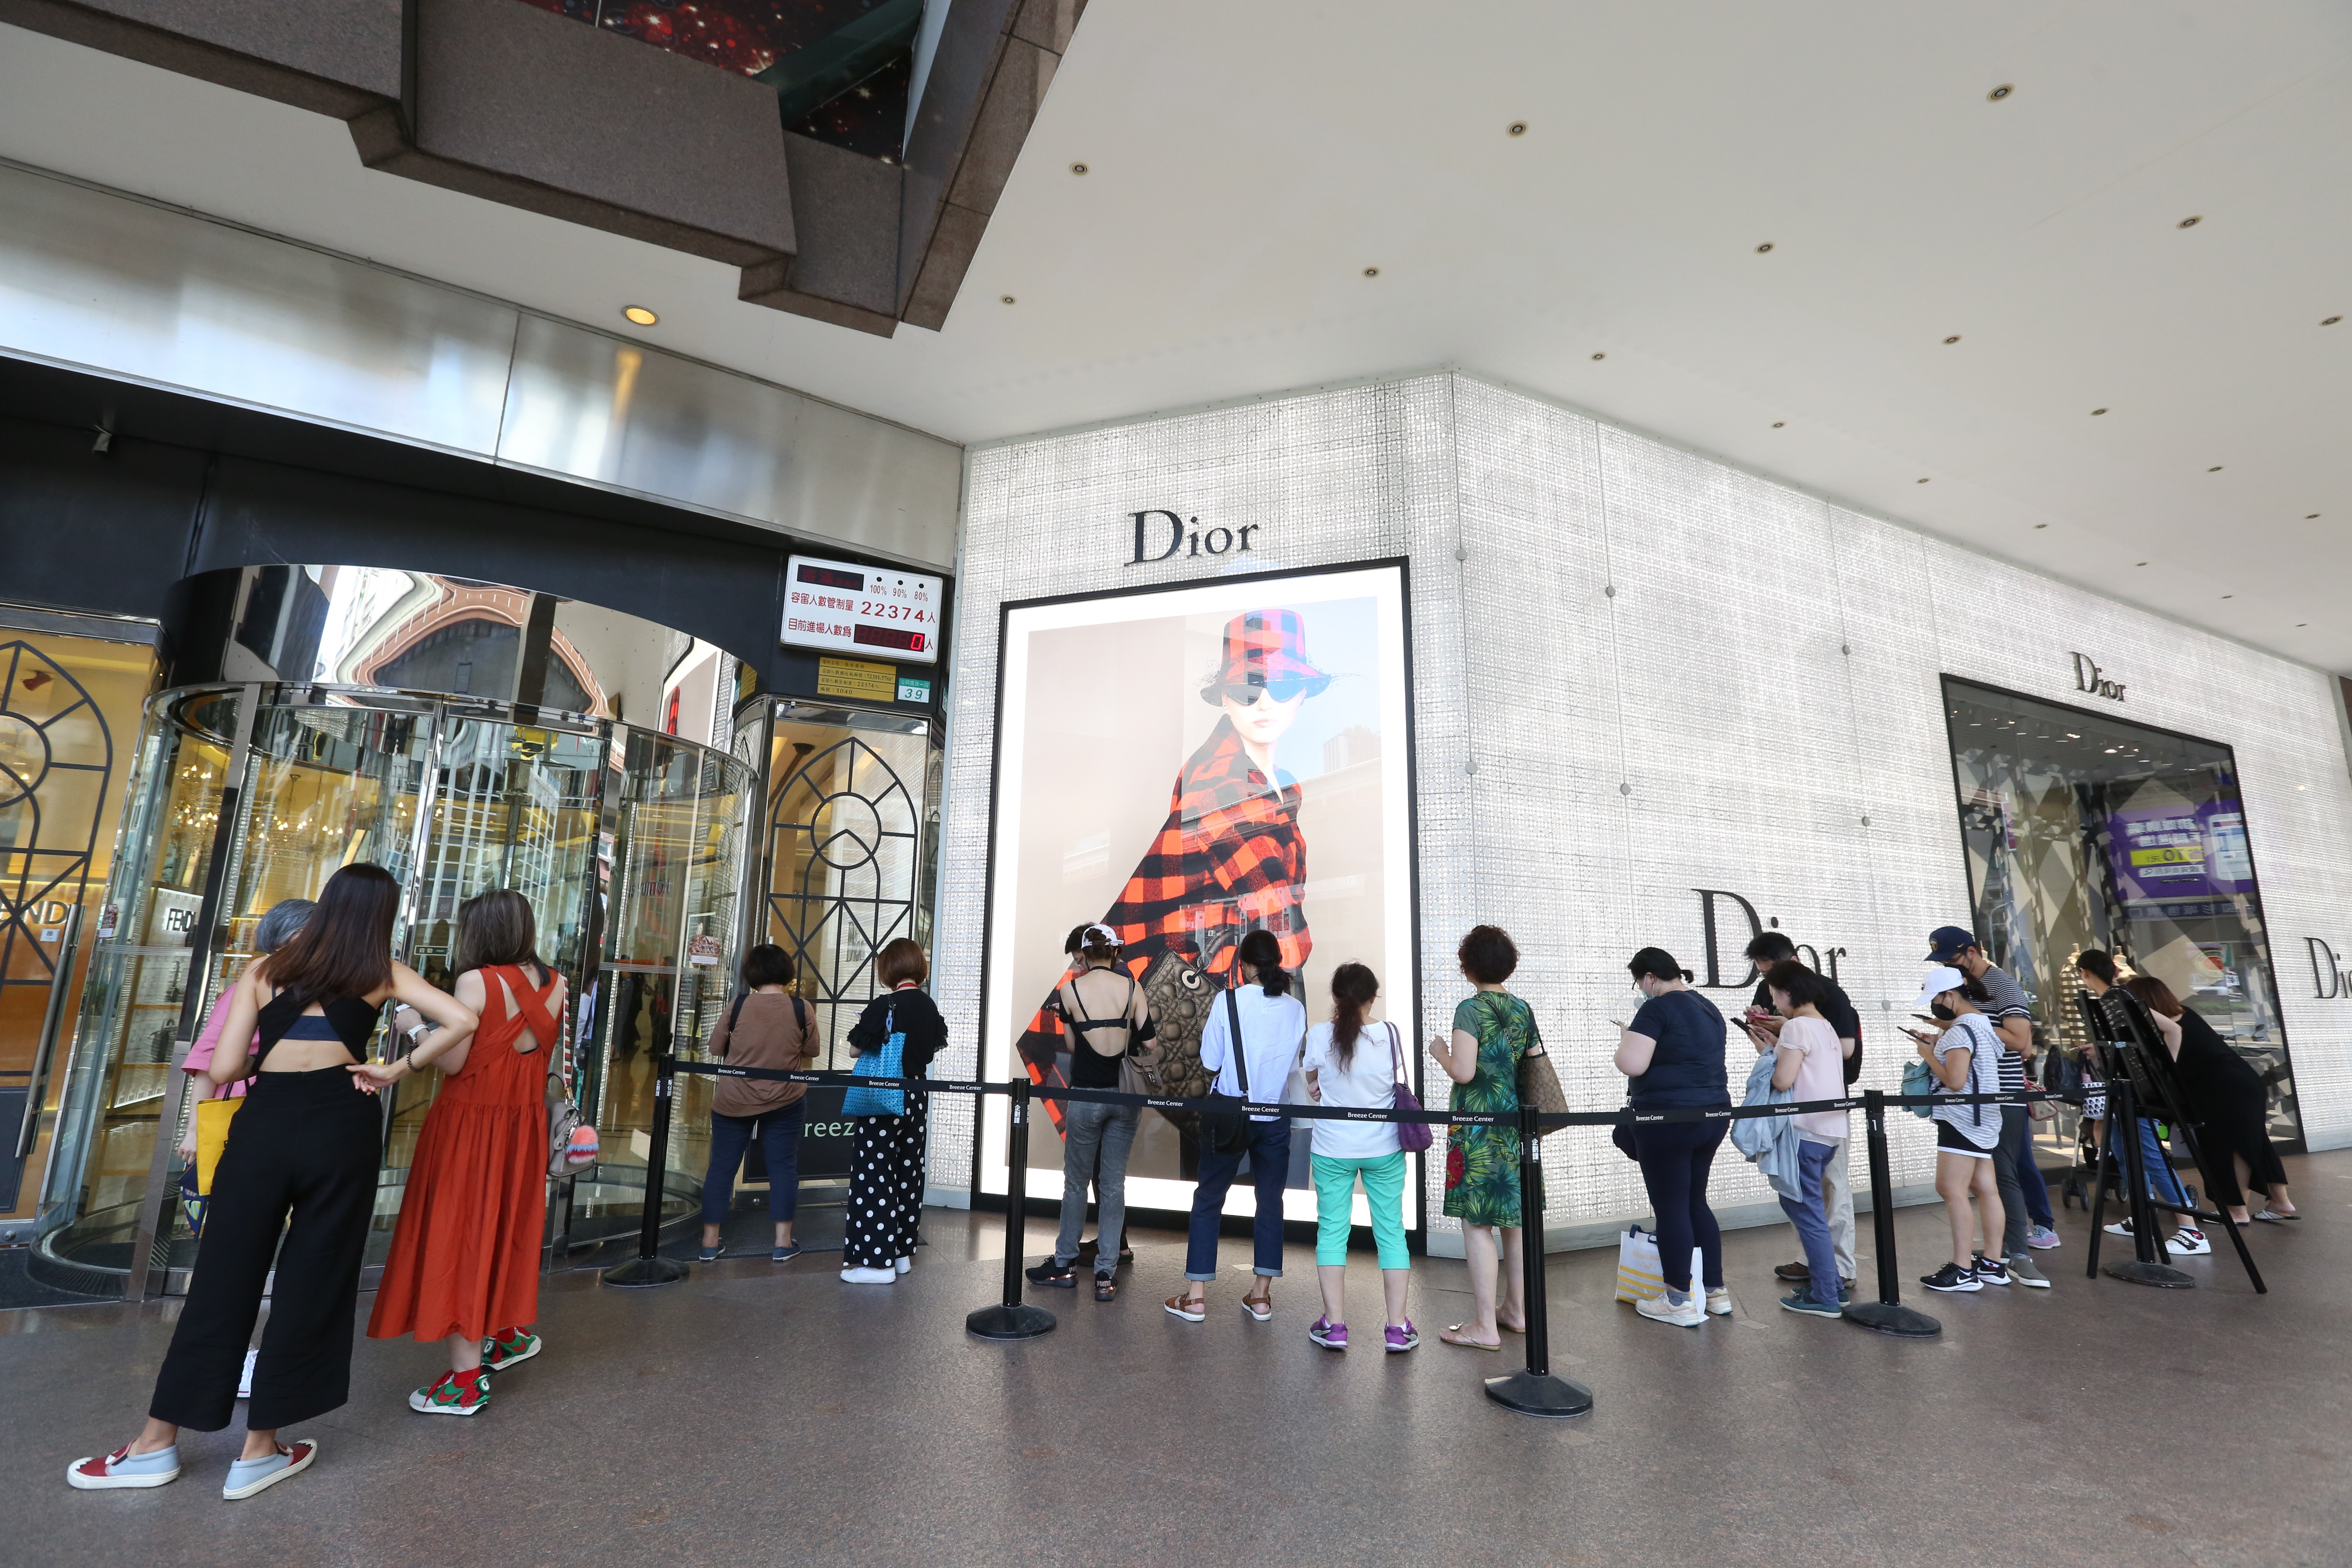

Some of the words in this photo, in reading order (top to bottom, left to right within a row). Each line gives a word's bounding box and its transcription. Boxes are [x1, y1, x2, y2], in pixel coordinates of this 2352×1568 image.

[1124, 510, 1258, 567] Dior
[870, 584, 887, 595] 100%
[893, 588, 907, 599] 90%
[914, 591, 928, 602] 80%
[791, 591, 854, 611] 容留人數管制量
[861, 601, 924, 623] 22374
[927, 611, 935, 624] 人
[910, 634, 924, 650] 0
[925, 638, 933, 650] 人
[2068, 651, 2126, 702] Dior
[905, 688, 923, 699] 39
[2303, 937, 2352, 998] Di
[804, 1122, 855, 1137] reez
